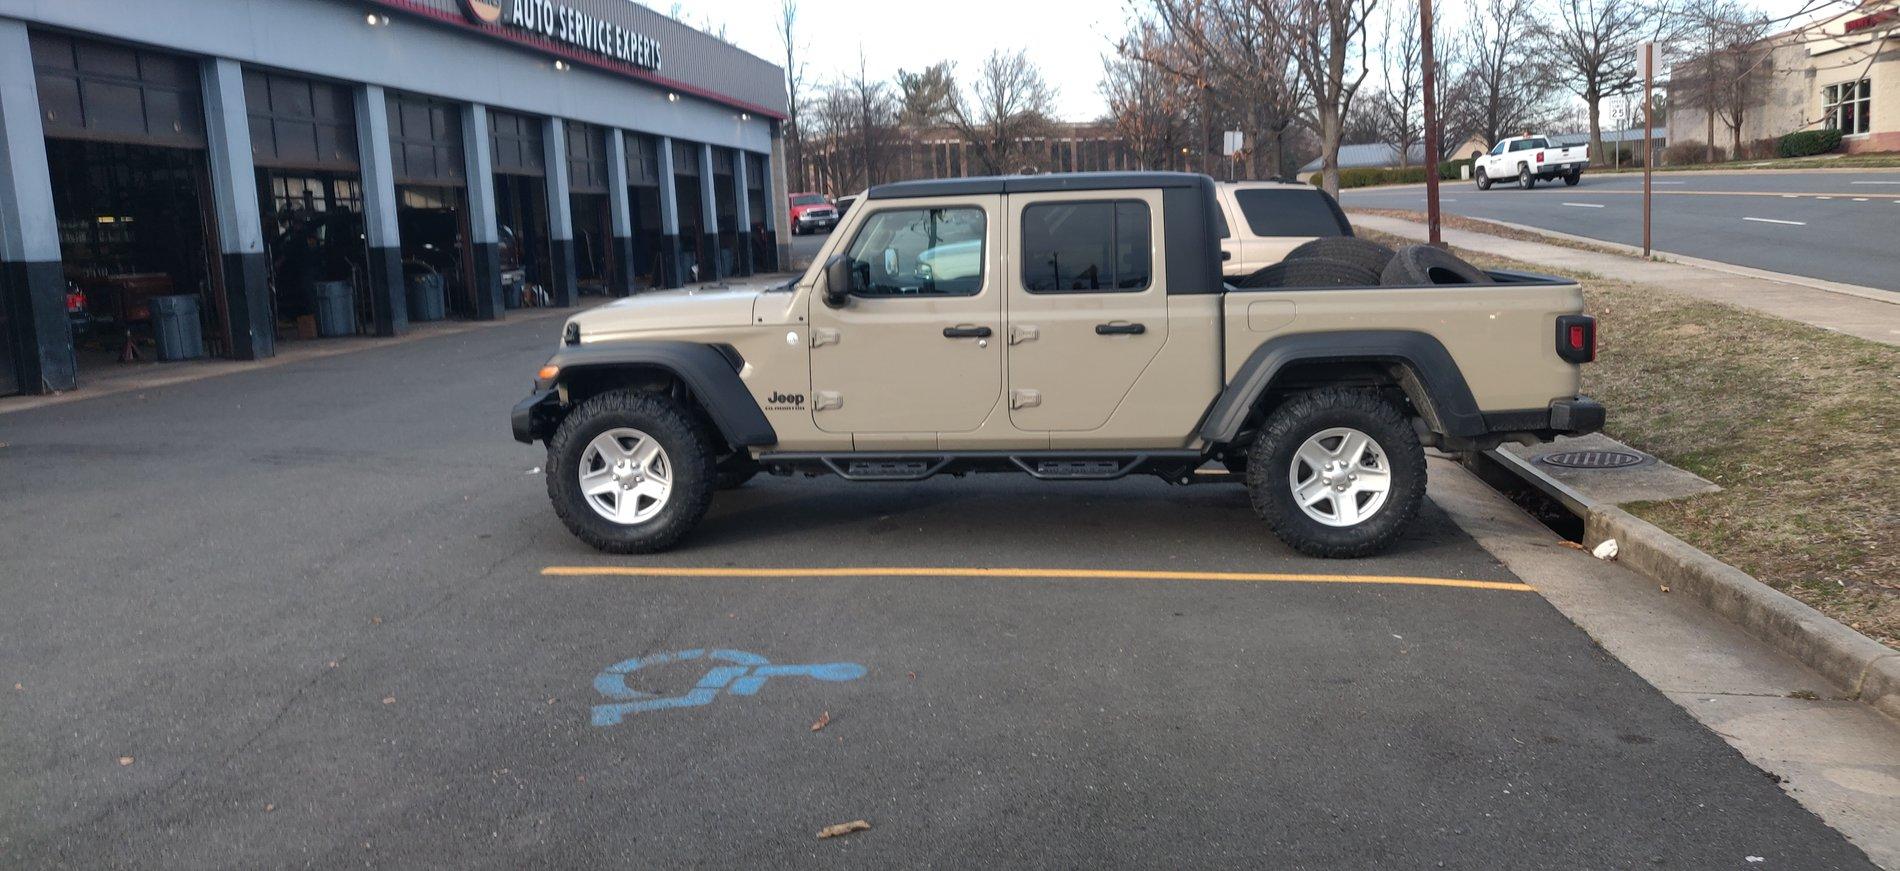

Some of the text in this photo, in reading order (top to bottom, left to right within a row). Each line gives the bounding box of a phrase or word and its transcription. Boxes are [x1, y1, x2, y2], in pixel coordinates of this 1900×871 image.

[513, 0, 662, 71] AUTO SERVICE EXPERTS
[1611, 108, 1624, 118] 25
[767, 391, 805, 406] Jeep
